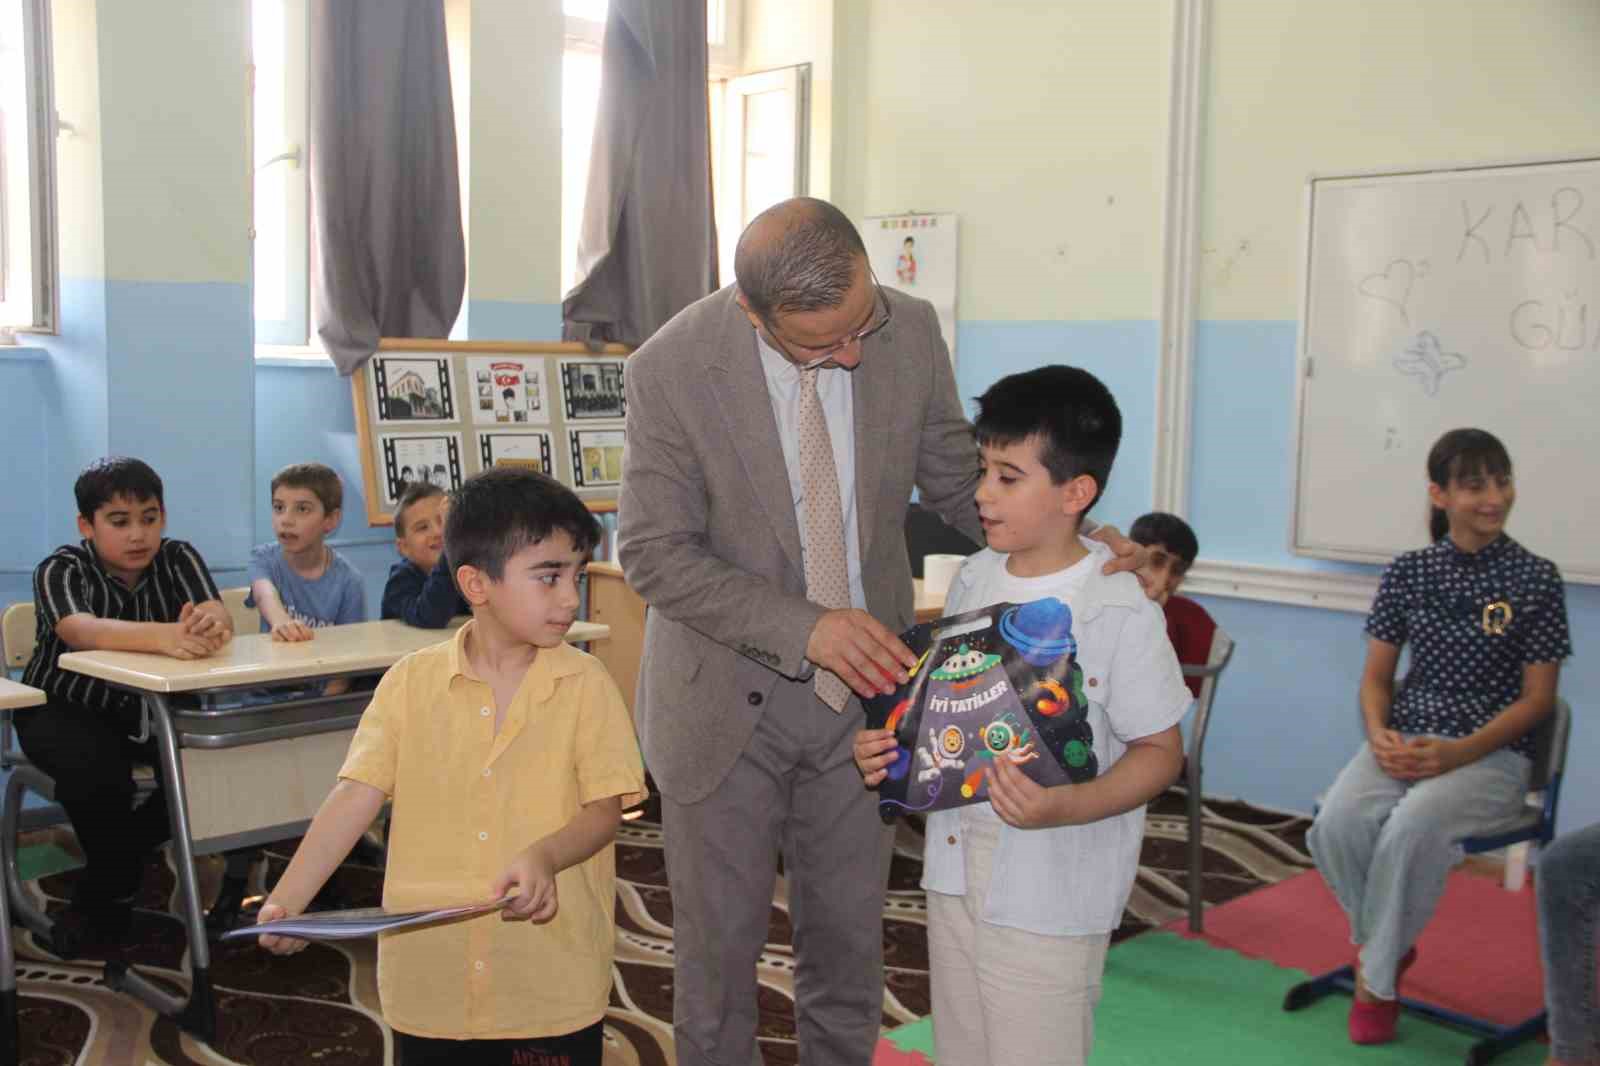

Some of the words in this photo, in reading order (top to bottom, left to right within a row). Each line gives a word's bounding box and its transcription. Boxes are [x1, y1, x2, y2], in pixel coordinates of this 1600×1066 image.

[1455, 185, 1596, 262] KAR
[1508, 288, 1600, 351] GÜ
[929, 694, 949, 712] İYİ
[951, 680, 1008, 712] TATİLLER
